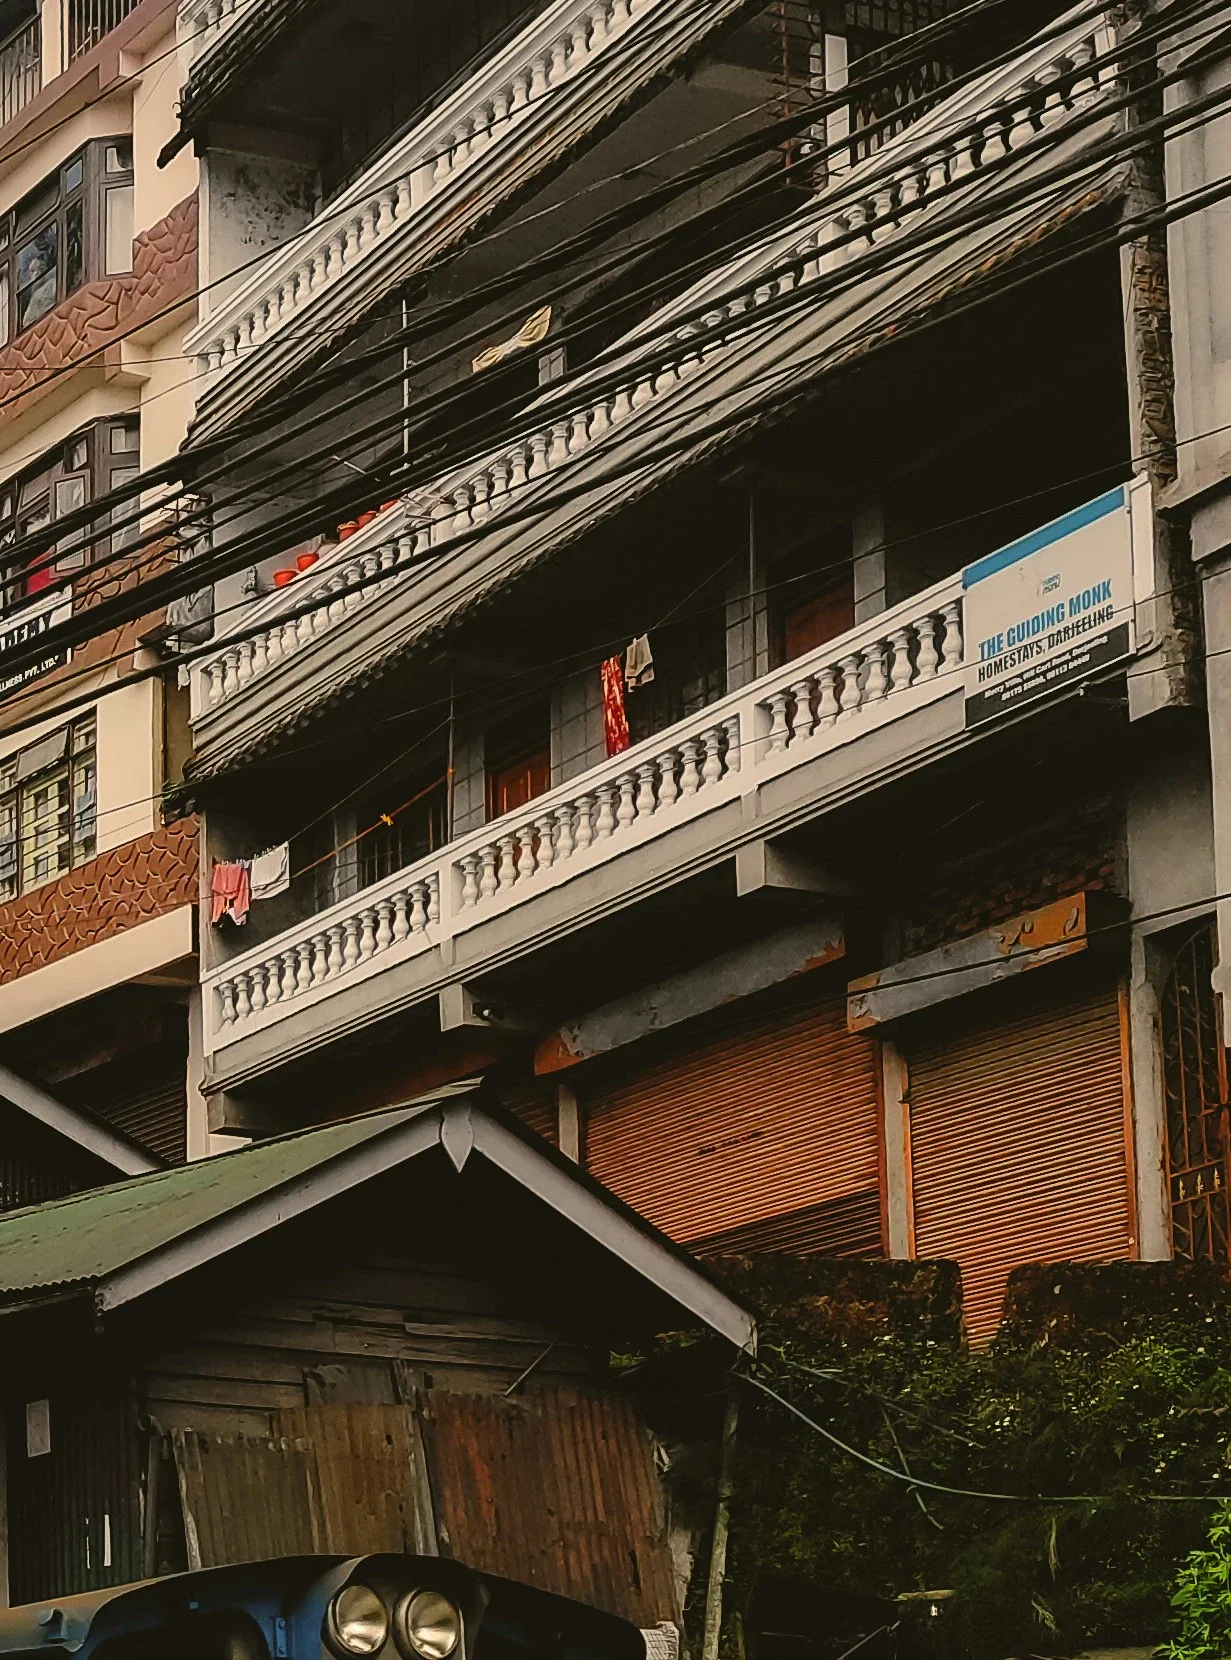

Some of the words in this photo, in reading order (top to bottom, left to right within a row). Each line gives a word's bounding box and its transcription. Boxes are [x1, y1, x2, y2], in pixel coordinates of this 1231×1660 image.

[978, 633, 1004, 661] THE
[1007, 603, 1065, 648] GUIDING
[1069, 578, 1112, 617] MONK
[978, 640, 1046, 683] HOMESTAYS,
[1048, 604, 1114, 649] DARJEELING
[1036, 662, 1051, 674] Cart
